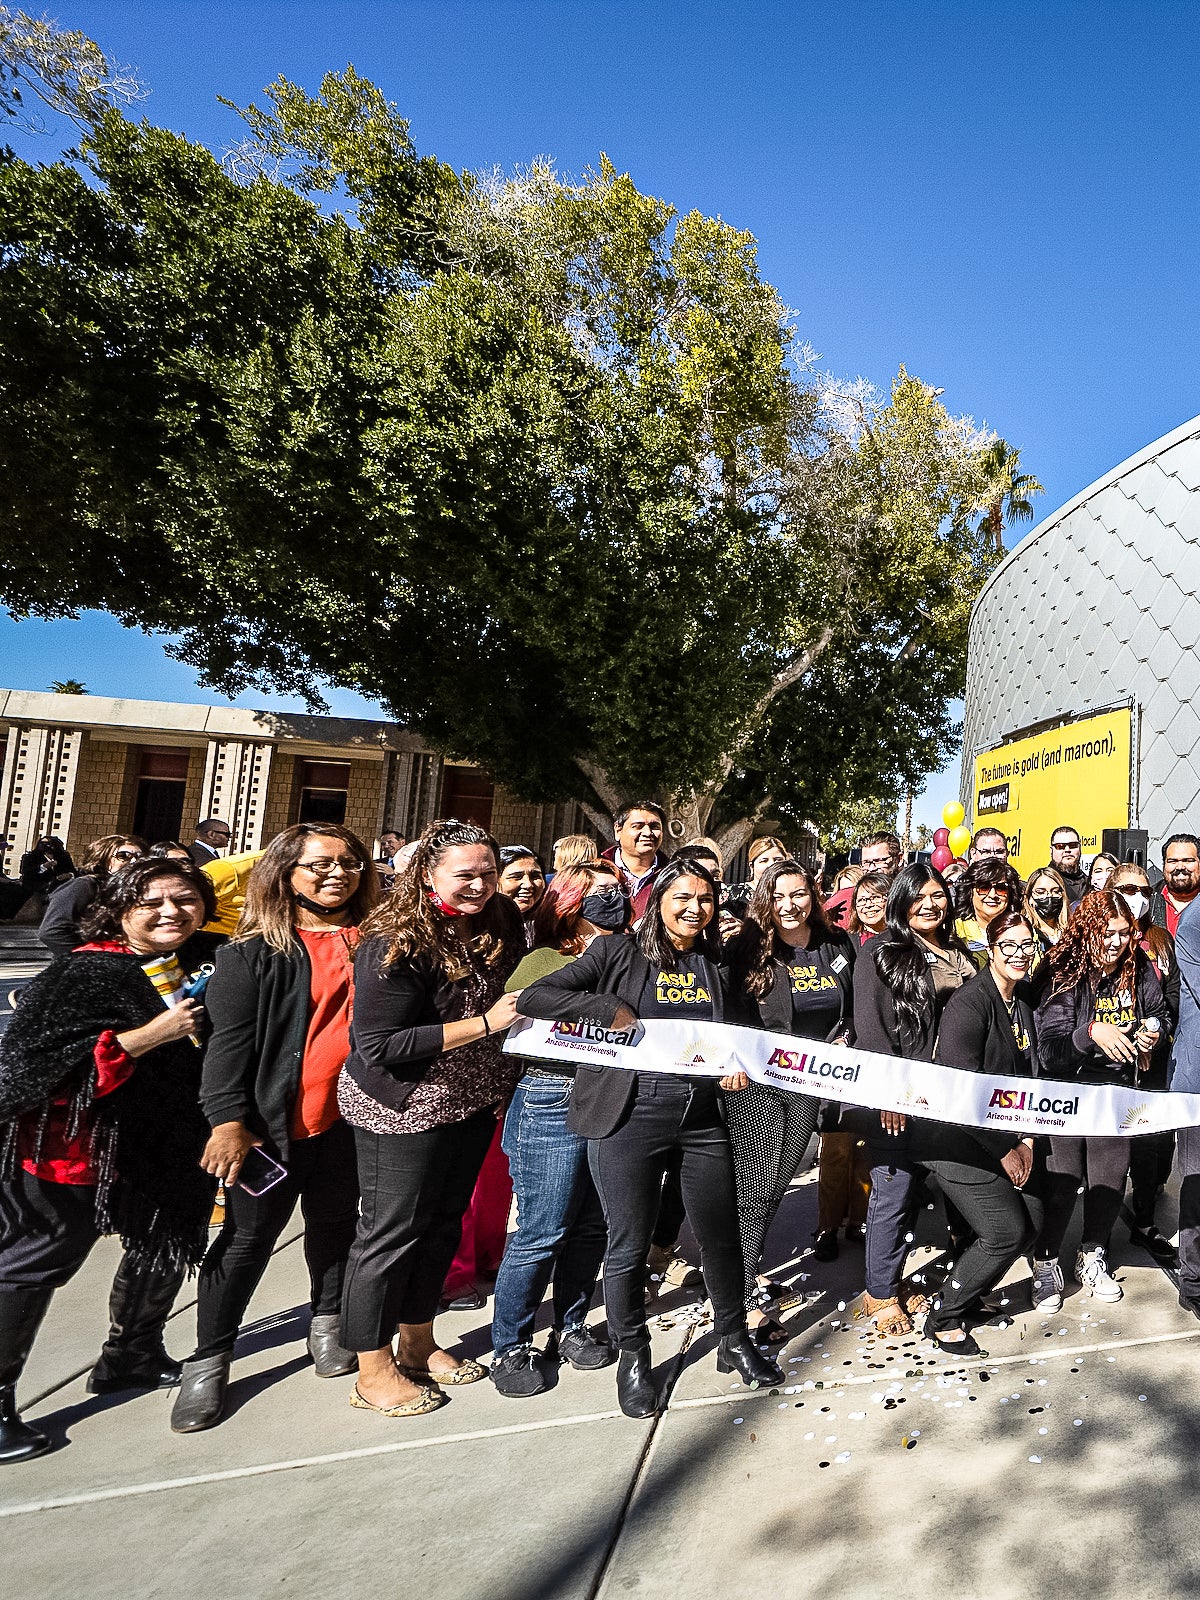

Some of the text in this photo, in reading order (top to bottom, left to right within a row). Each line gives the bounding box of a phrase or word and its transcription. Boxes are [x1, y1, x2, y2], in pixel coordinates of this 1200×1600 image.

[981, 730, 1116, 783] The future is gold (and maroon).
[978, 787, 1009, 810] Now open!
[1080, 835, 1097, 847] local
[656, 971, 697, 988] ASU
[656, 987, 712, 1004] LOCA
[550, 1020, 637, 1047] ASU Local
[545, 1037, 618, 1058] Arizona State University
[767, 1048, 861, 1082] ASU Local
[763, 1069, 790, 1083] Arizona
[791, 1075, 807, 1086] Stat
[988, 1088, 1080, 1116] ASU Local
[986, 1111, 1013, 1122] Arizona
[1013, 1114, 1031, 1123] Stte
